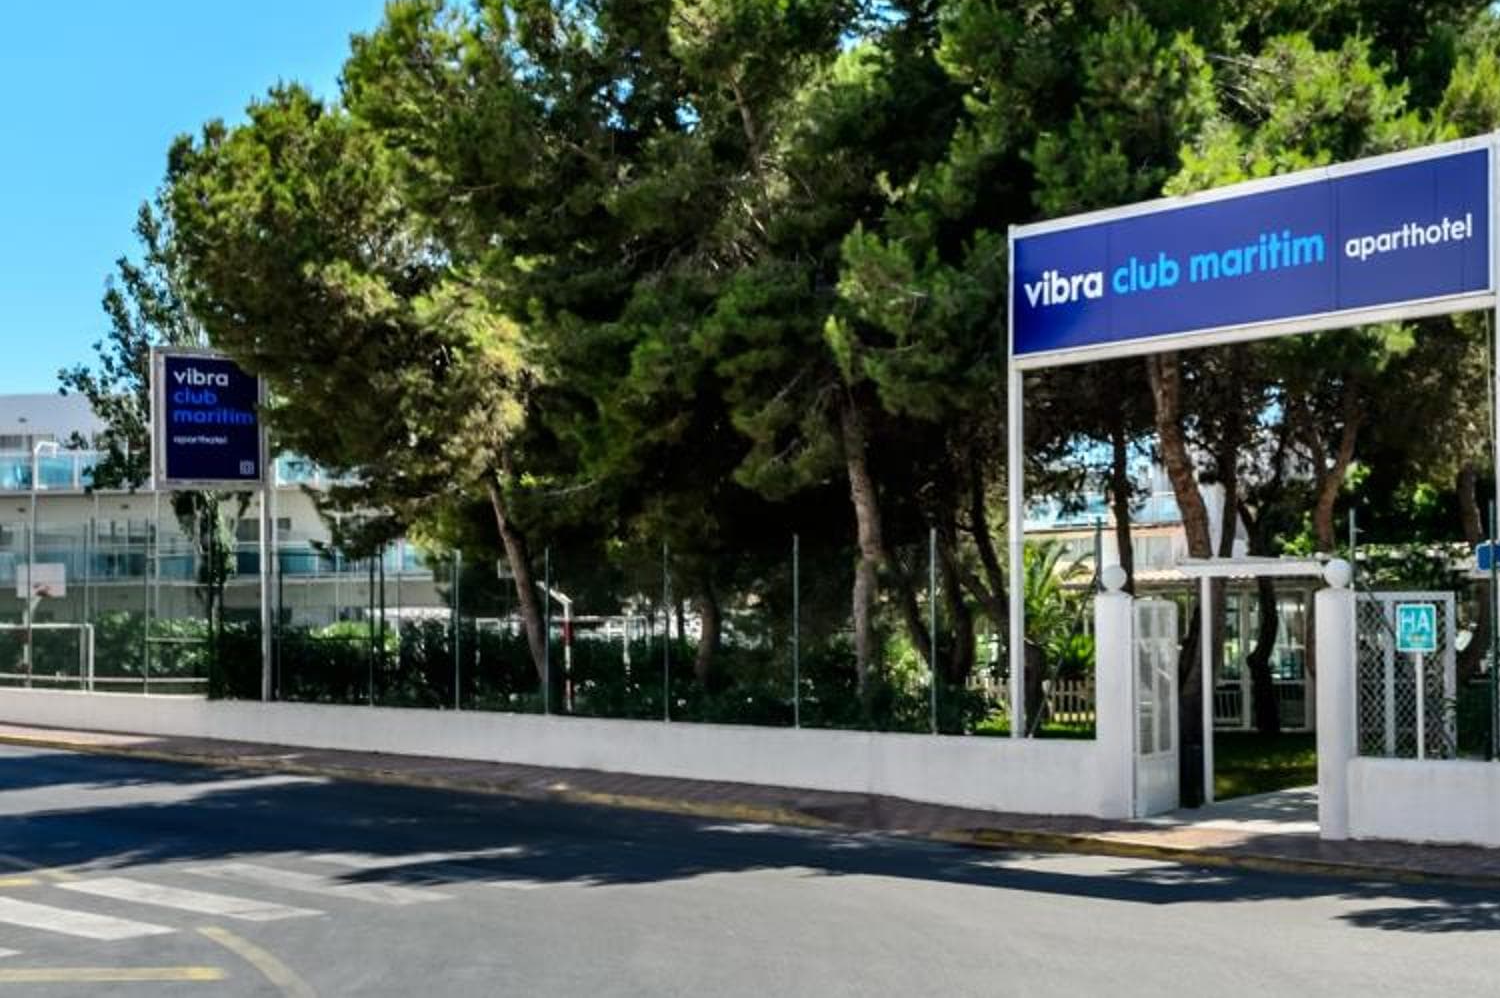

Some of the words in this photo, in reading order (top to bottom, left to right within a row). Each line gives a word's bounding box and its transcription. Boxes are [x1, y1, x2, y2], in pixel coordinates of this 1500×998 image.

[1024, 268, 1103, 308] vibra
[1112, 251, 1179, 295] club
[1189, 229, 1325, 283] maritim
[1345, 212, 1473, 260] aparthotel
[173, 367, 229, 387] vibra
[173, 386, 217, 405] club
[173, 408, 255, 426] maritim
[1401, 609, 1431, 633] HA
